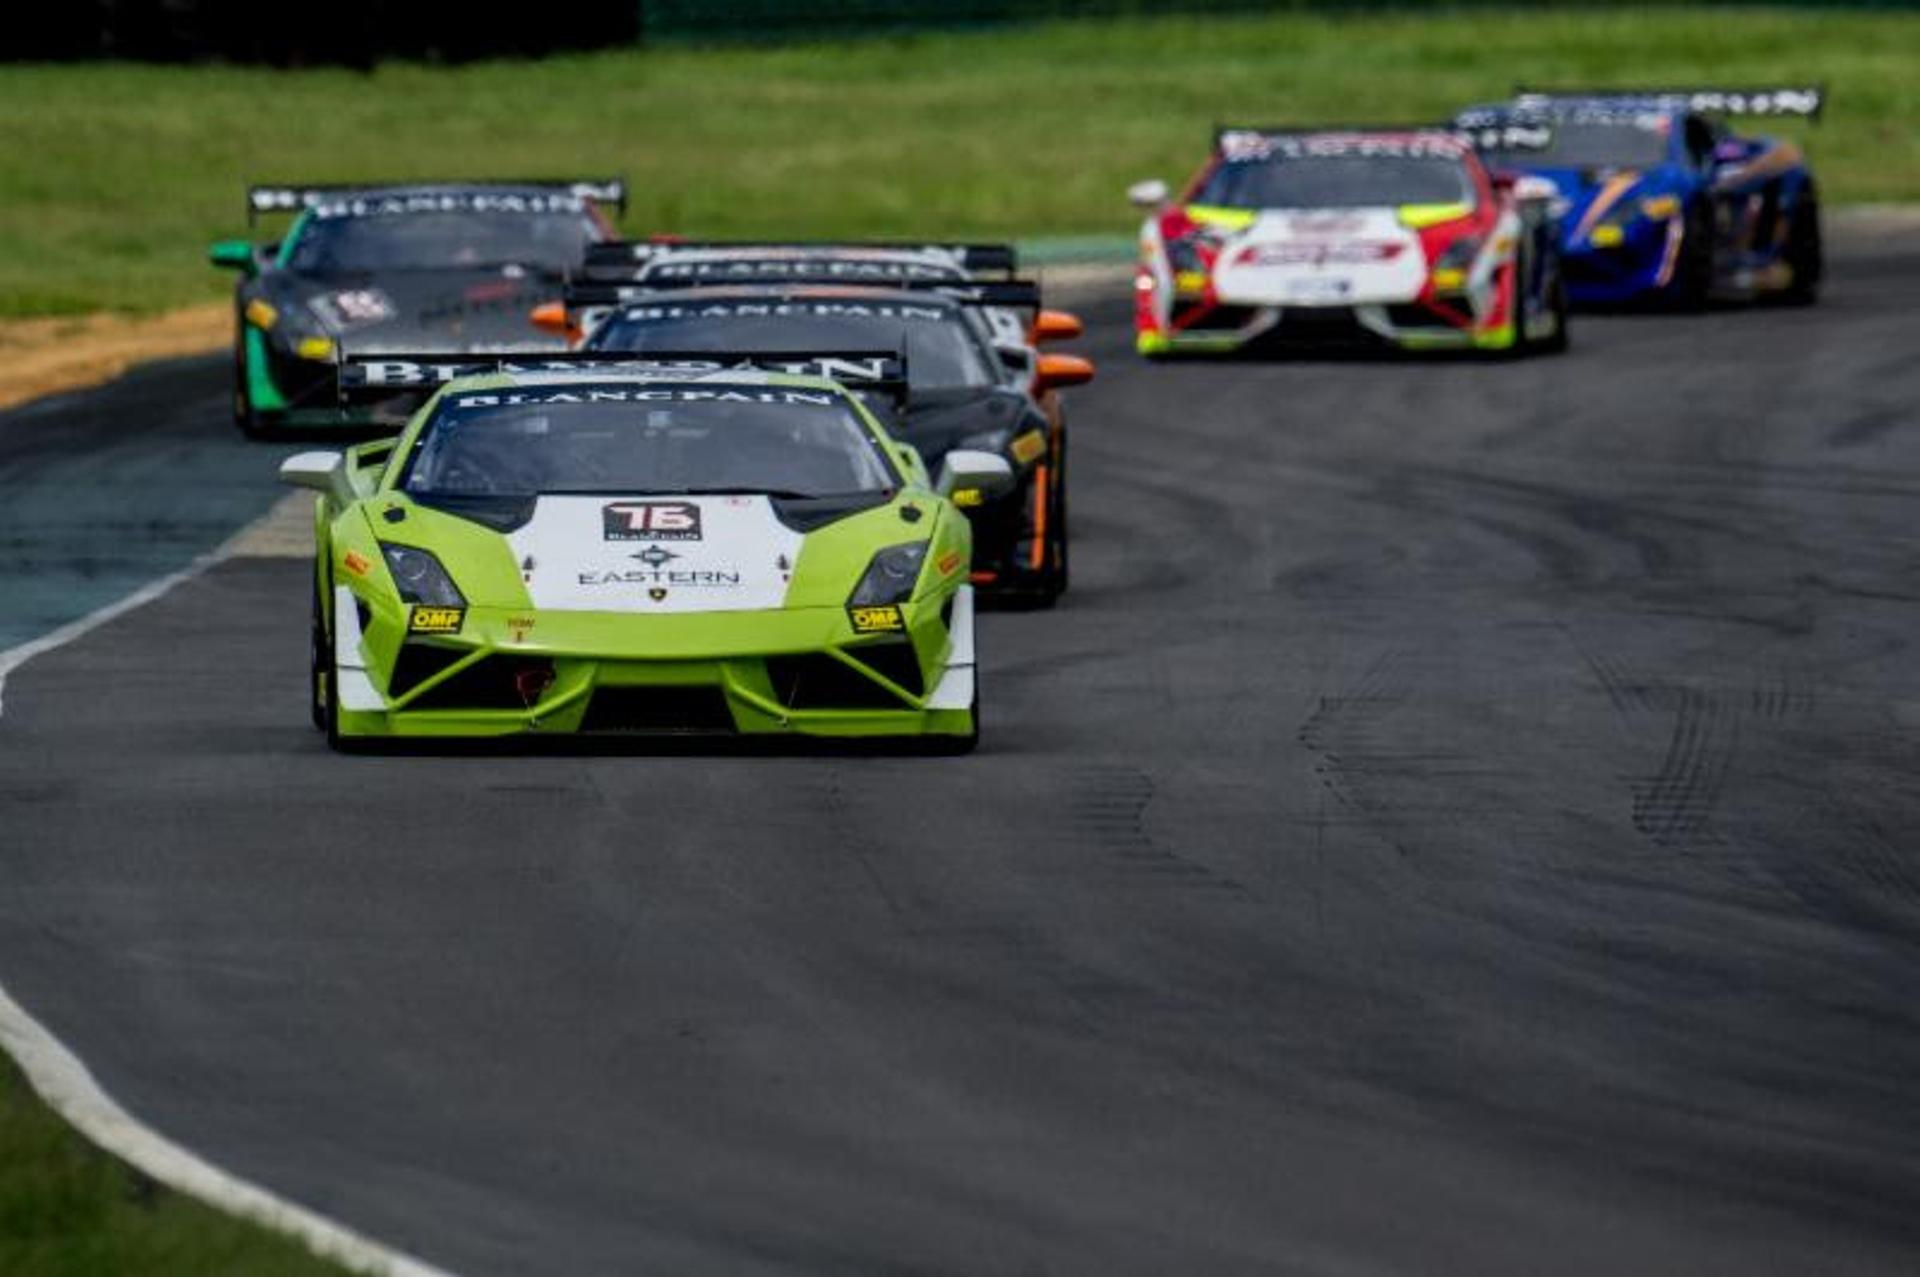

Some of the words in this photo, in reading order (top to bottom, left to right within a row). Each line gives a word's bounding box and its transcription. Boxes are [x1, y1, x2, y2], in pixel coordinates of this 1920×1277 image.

[628, 304, 942, 321] BLANCPAIN
[459, 391, 831, 407] BLANCPAIN
[578, 571, 741, 585] EASTERN
[414, 610, 461, 626] OMP
[855, 610, 899, 625] OMP
